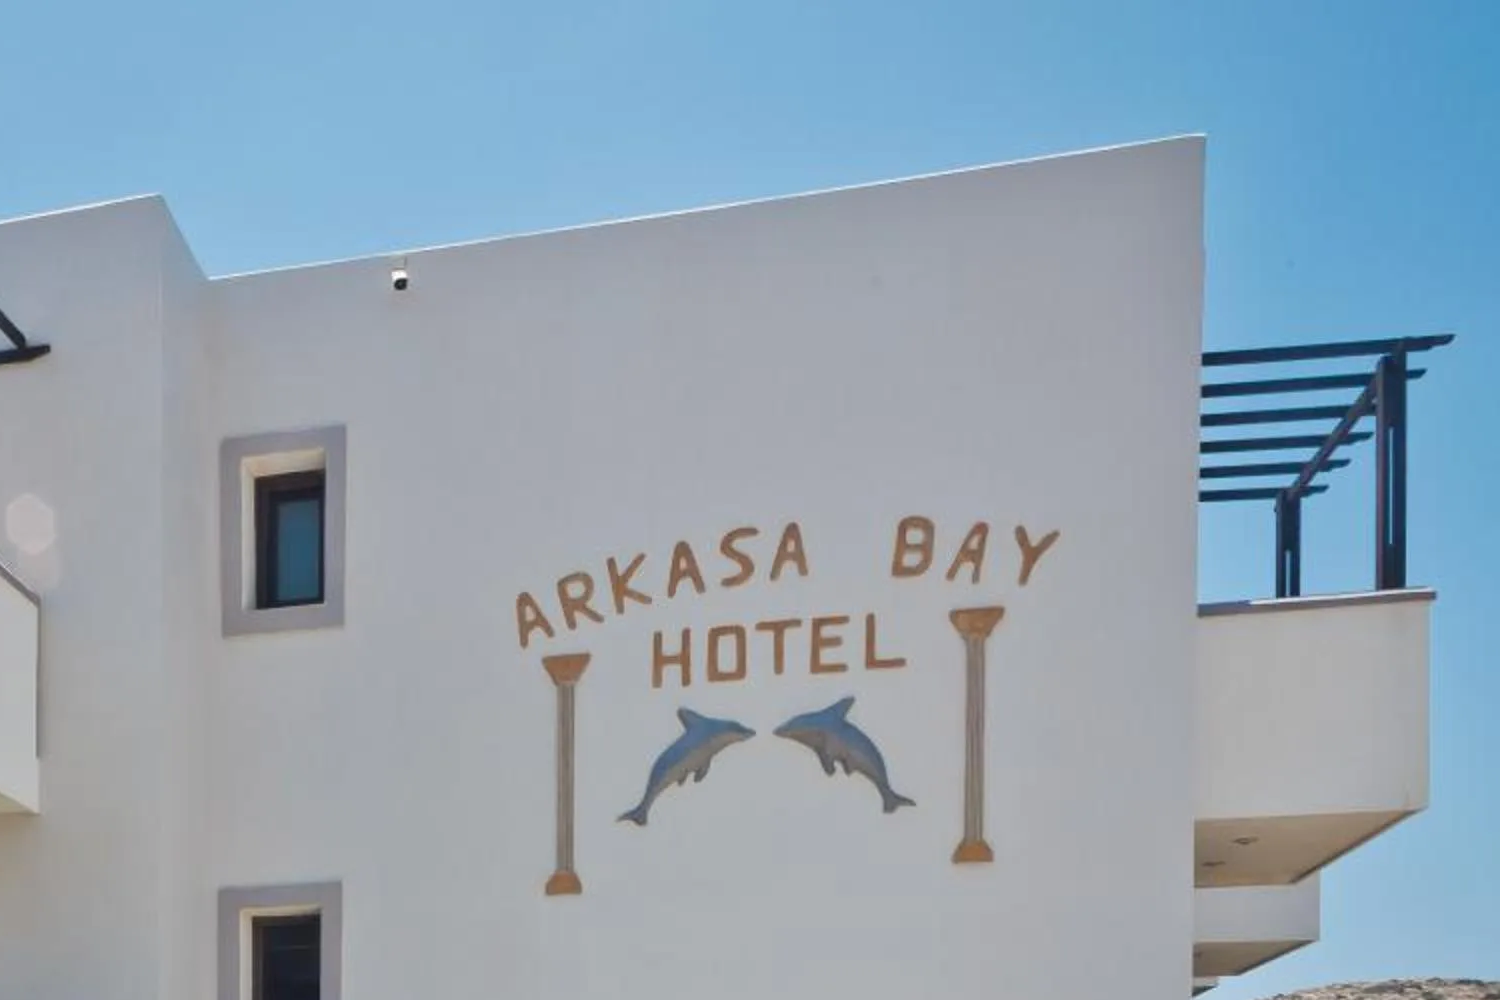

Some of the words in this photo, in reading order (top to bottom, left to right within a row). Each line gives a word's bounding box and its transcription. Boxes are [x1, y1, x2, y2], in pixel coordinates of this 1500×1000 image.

[516, 522, 809, 649] ARKASA
[891, 516, 1060, 585] BAY
[652, 613, 906, 688] HOTEL
